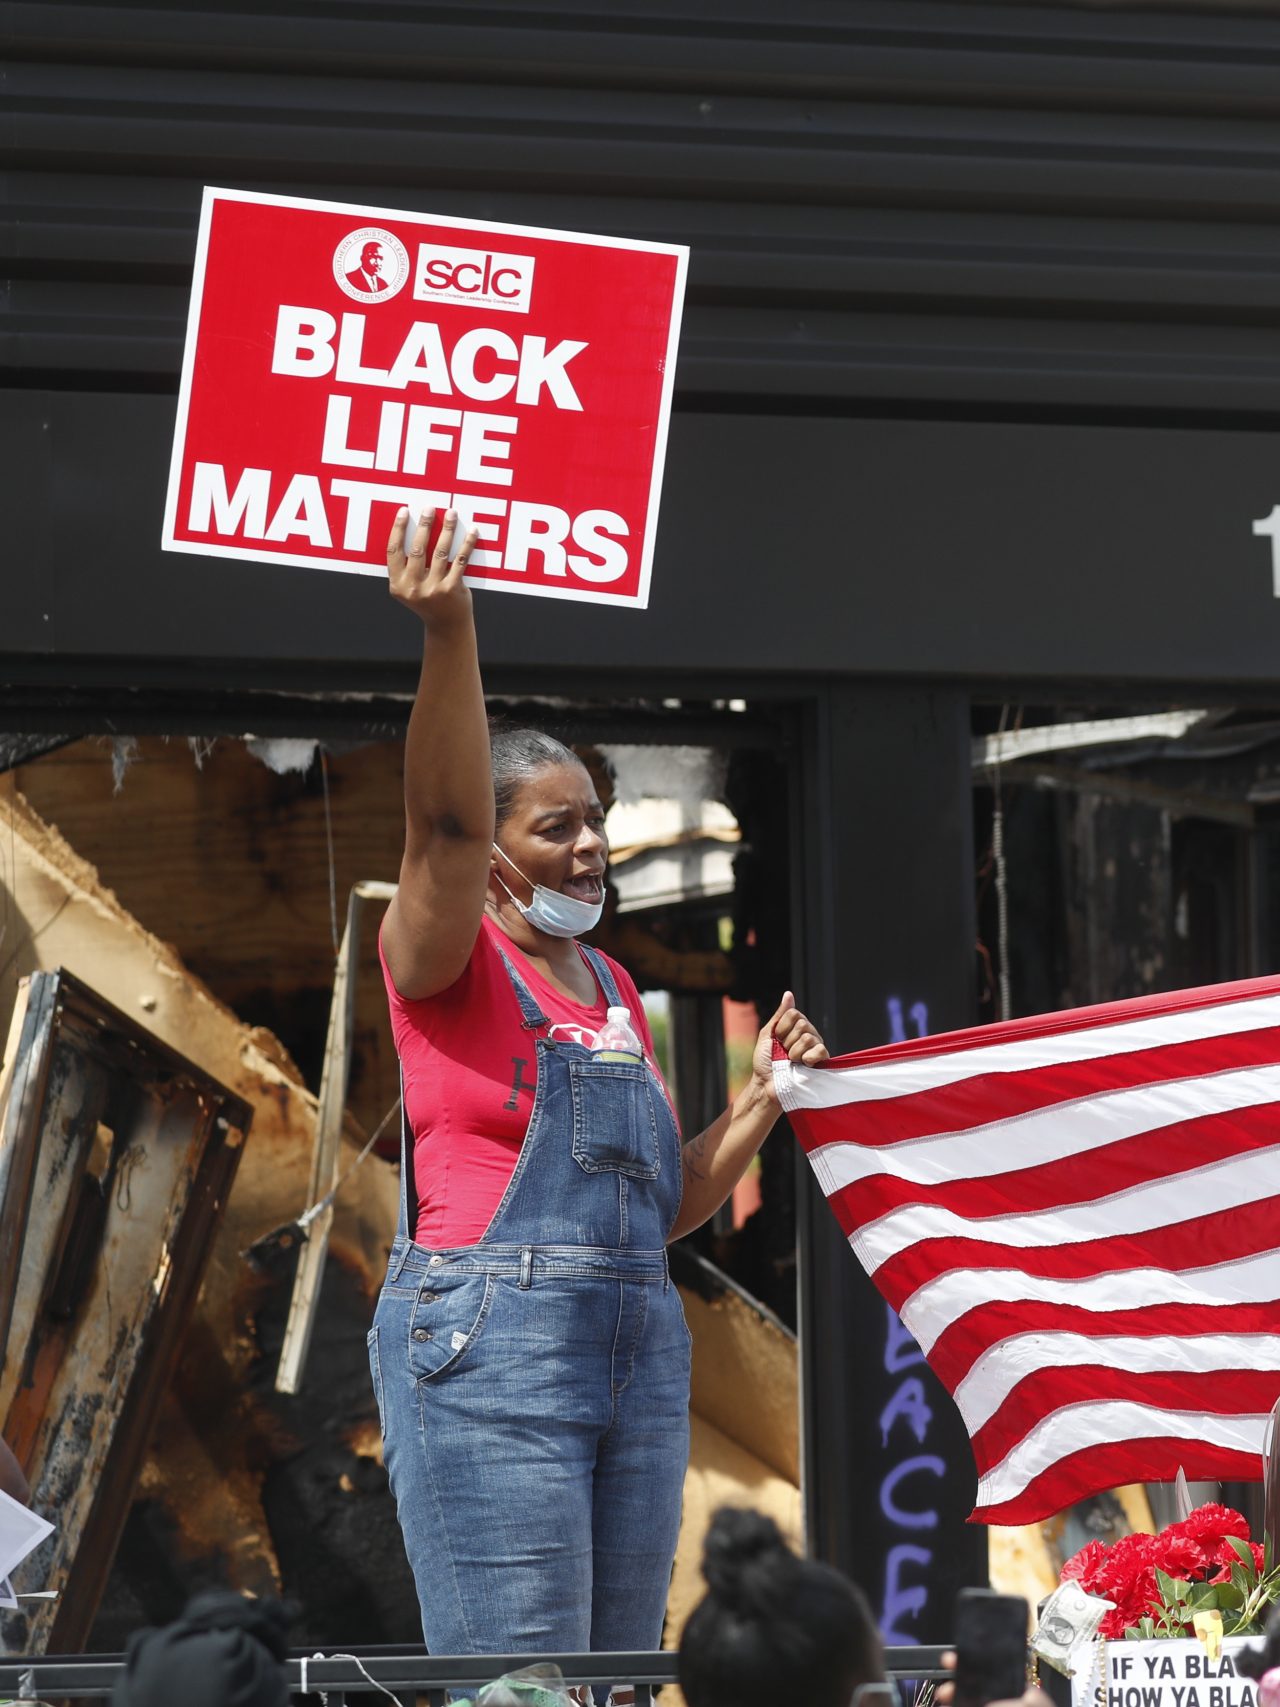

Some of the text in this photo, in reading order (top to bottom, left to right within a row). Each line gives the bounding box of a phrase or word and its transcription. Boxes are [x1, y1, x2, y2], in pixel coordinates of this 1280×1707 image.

[424, 254, 522, 298] sclc
[271, 304, 590, 412] BLACK
[321, 394, 518, 486] LIFE
[1112, 1655, 1235, 1680] IF YA BLA
[1094, 1687, 1162, 1707] SHOW
[1171, 1686, 1201, 1707] YA
